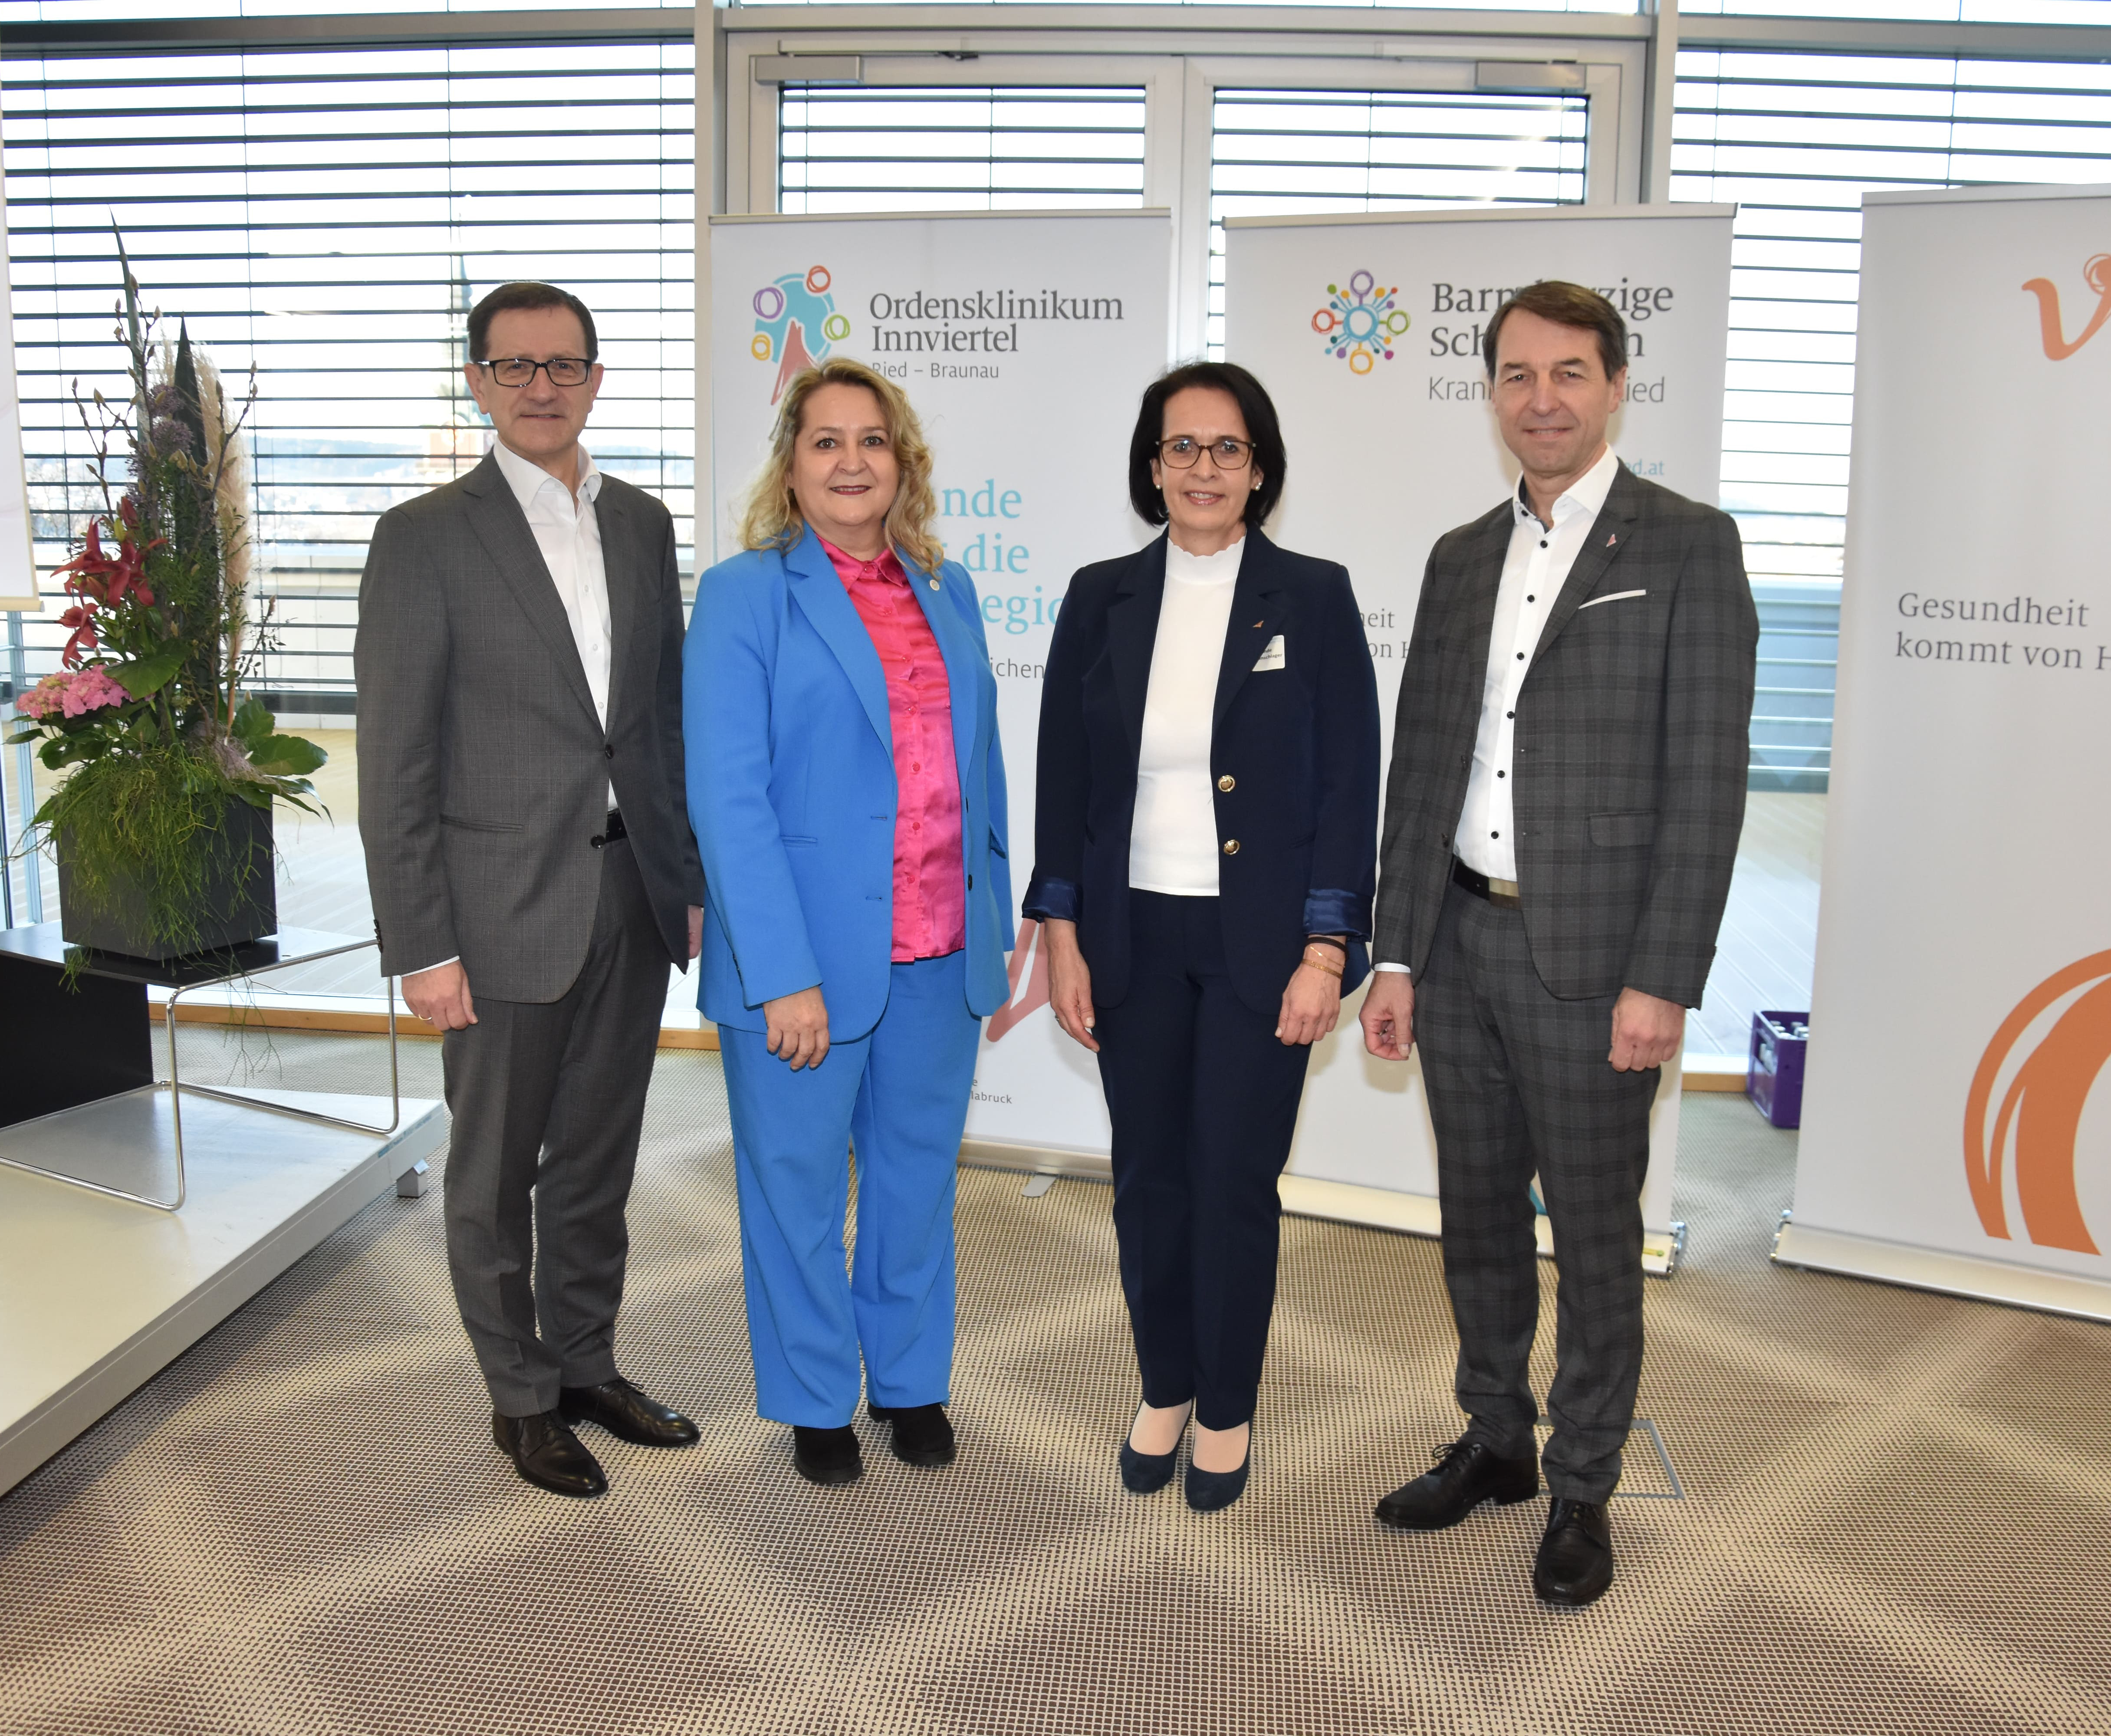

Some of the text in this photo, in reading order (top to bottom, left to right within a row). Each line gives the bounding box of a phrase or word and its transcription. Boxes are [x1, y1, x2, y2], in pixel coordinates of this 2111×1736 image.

[870, 289, 1124, 320] Ordensklinikum
[872, 322, 1019, 353] Innviertel
[931, 362, 999, 378] Braunau
[1621, 376, 1665, 403] ied
[962, 533, 1029, 574] die
[1898, 592, 2089, 627] Gesundheit
[1895, 631, 2012, 664] kommt
[2023, 646, 2082, 669] von
